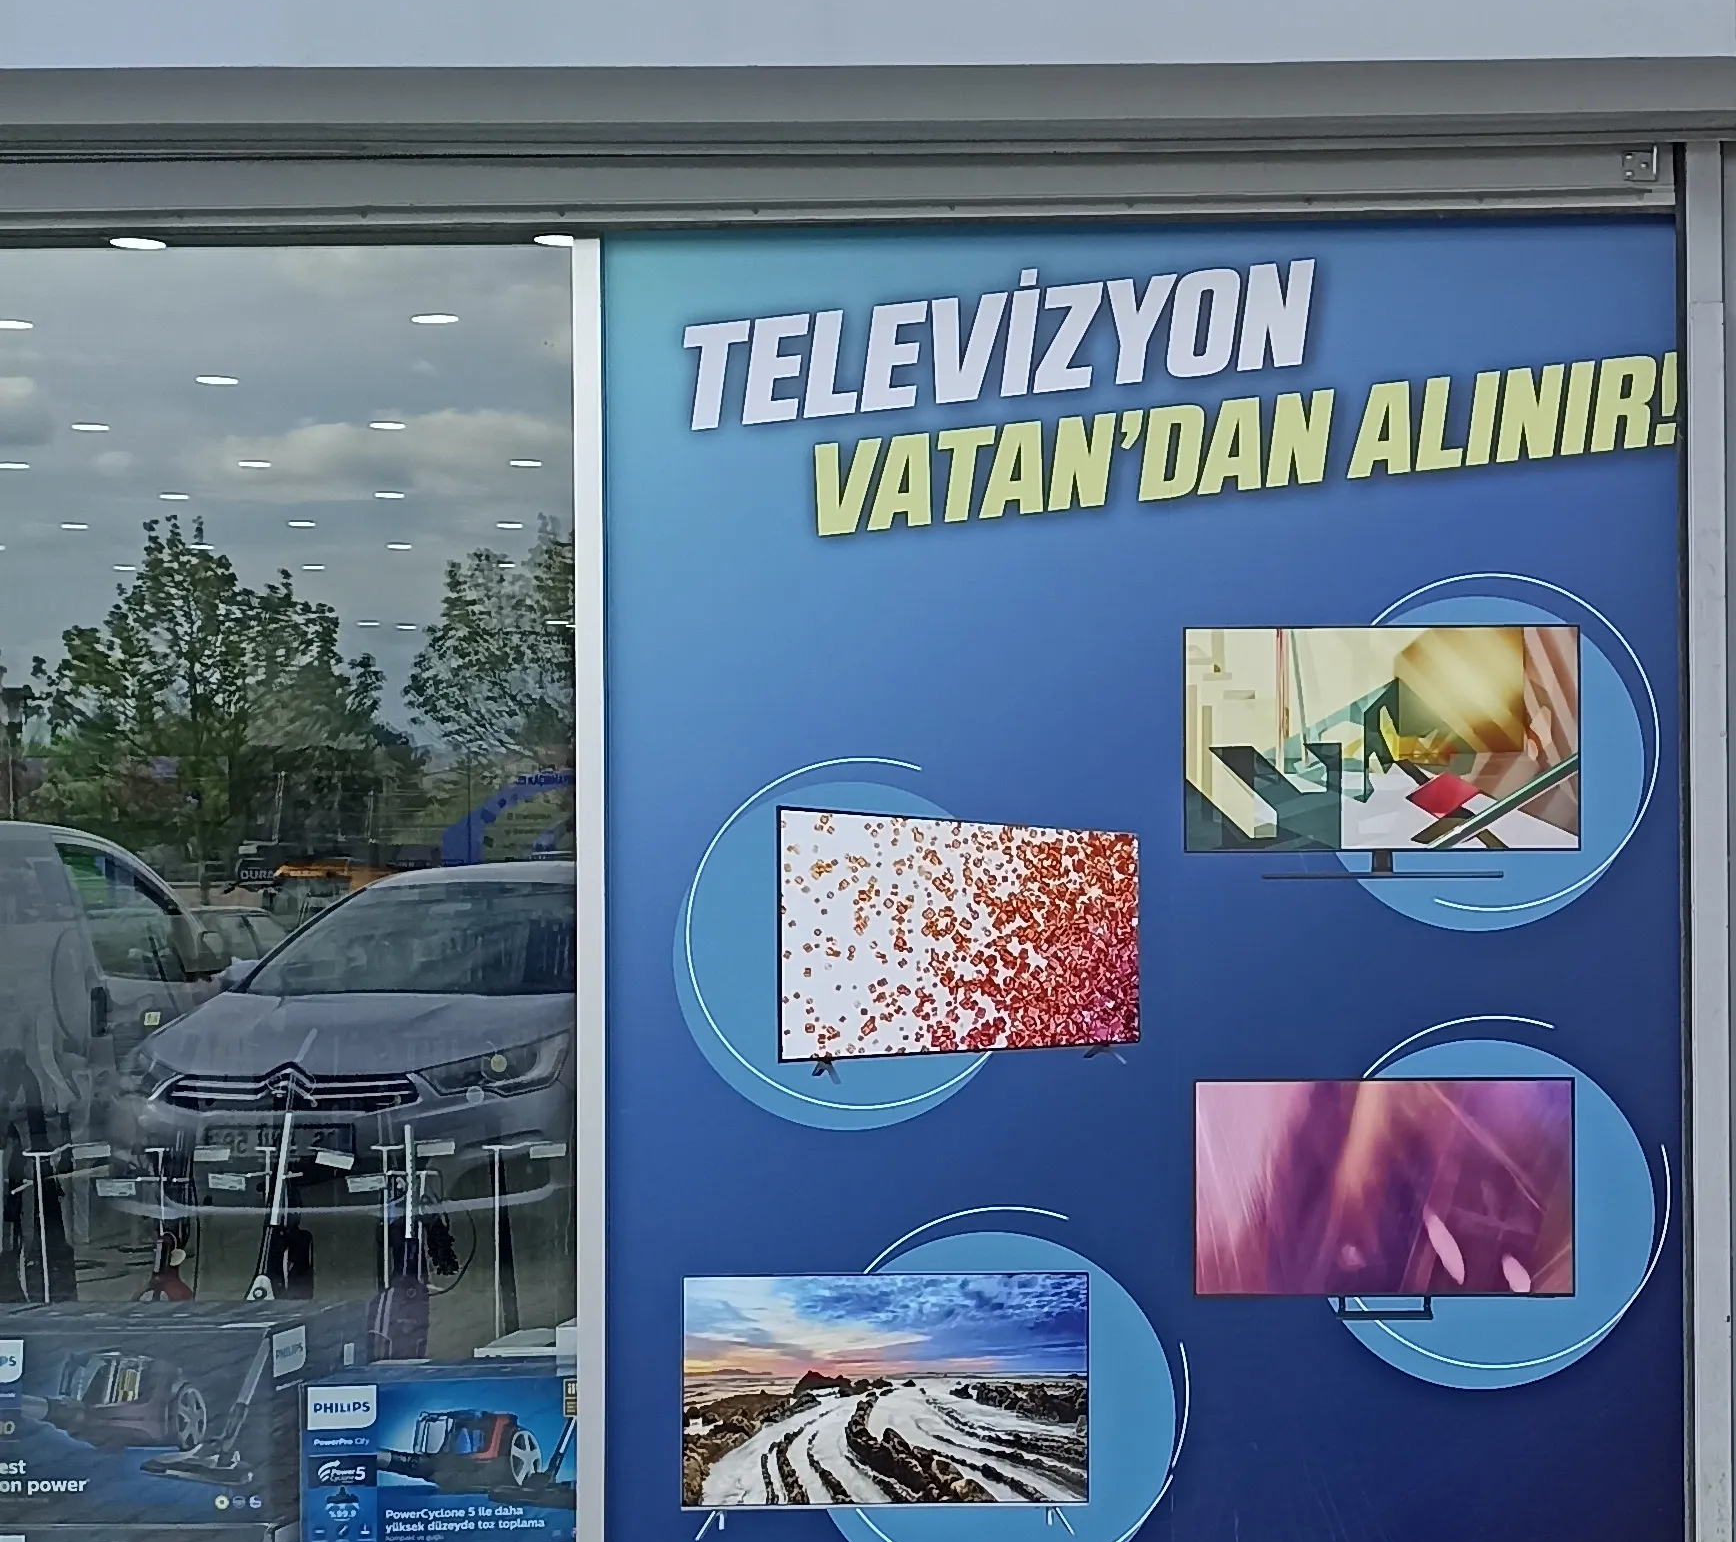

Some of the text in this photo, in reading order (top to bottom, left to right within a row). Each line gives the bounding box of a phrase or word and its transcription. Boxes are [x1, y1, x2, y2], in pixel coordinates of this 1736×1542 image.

[681, 258, 1317, 430] TELEVİZYON
[1346, 351, 1678, 479] ALINIR!
[313, 1402, 371, 1413] PHILIPS
[355, 1466, 366, 1480] 5
[385, 1508, 465, 1520] PowerCyclone
[468, 1507, 475, 1517] 5
[494, 1506, 523, 1516] daha
[385, 1518, 545, 1533] yüksek düzeyde toz toplama
